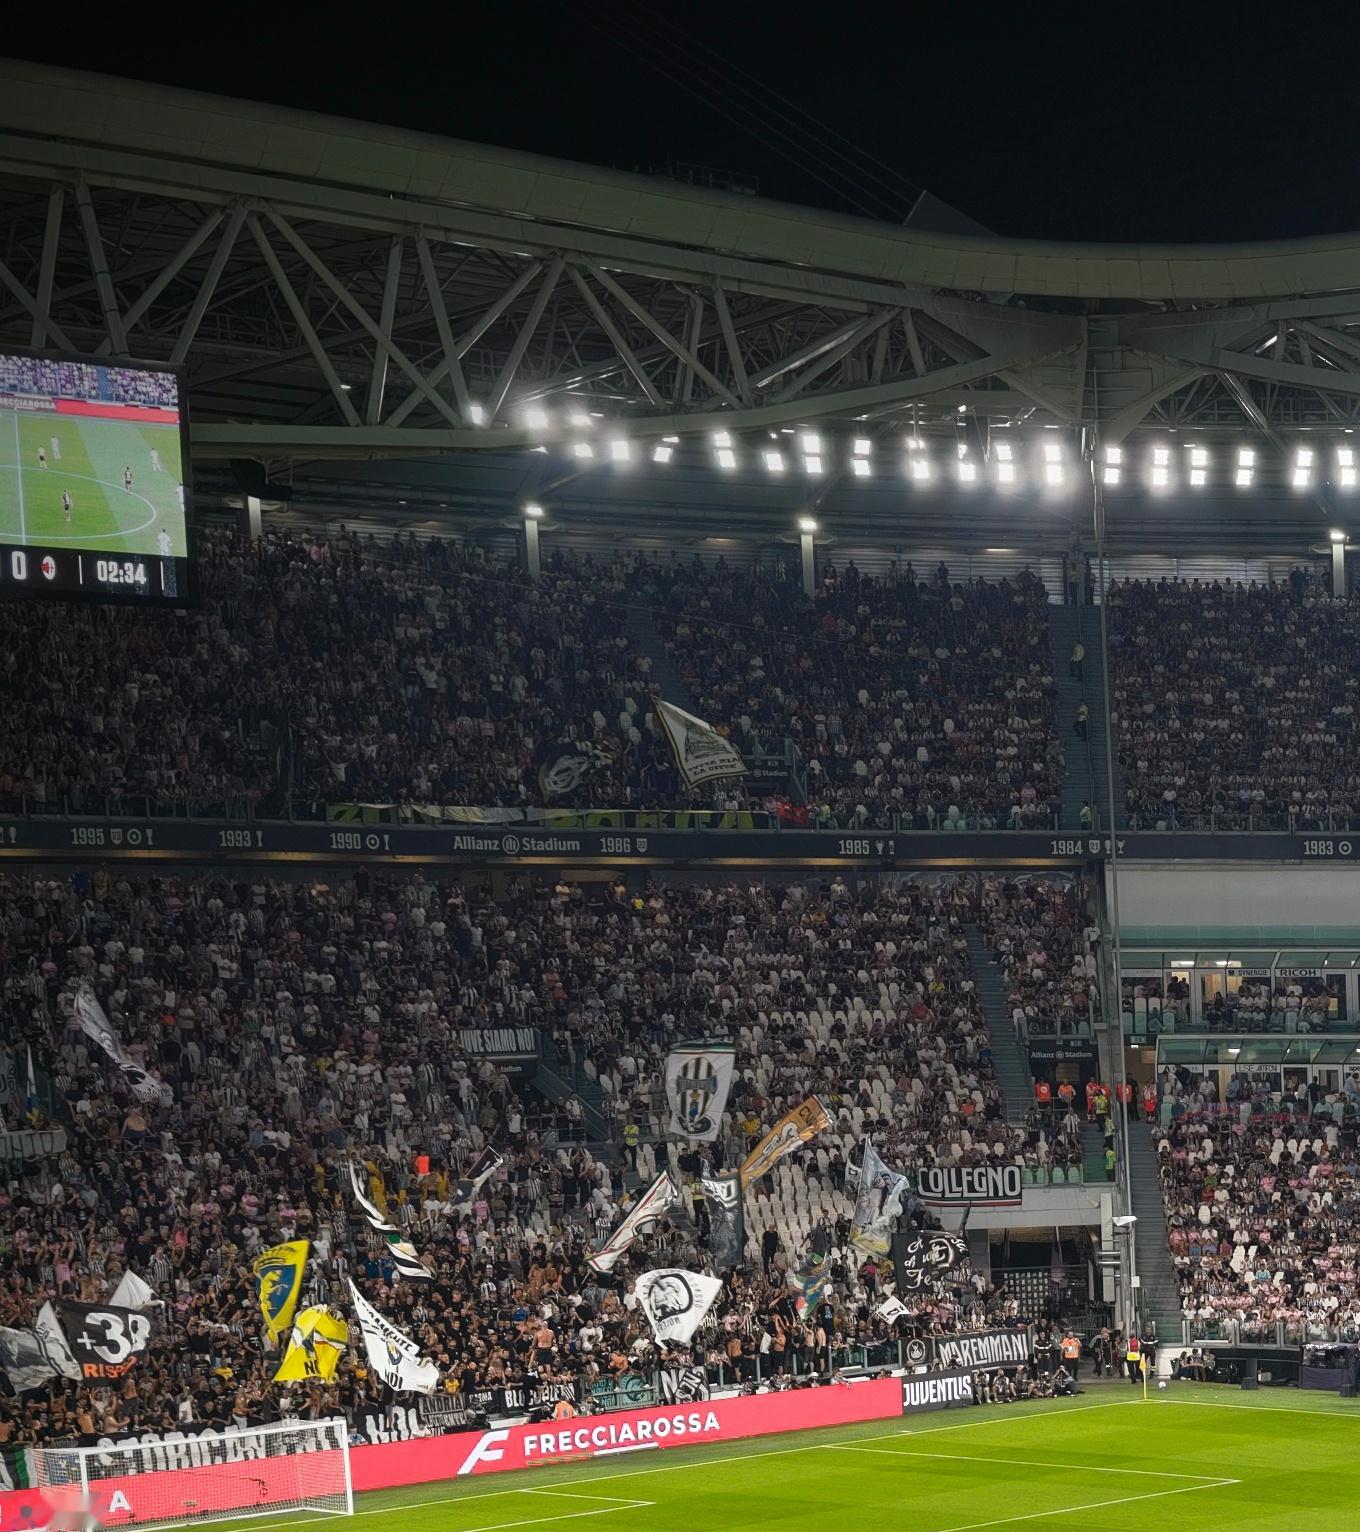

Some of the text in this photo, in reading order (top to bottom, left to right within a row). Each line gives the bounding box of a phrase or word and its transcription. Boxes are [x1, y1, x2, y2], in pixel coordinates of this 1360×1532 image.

[13, 551, 28, 580] 0
[97, 560, 147, 585] 02:34
[71, 828, 105, 845] 1995
[219, 830, 252, 847] 1993
[330, 833, 362, 849] 1990
[454, 835, 580, 851] Allianz Stadium
[600, 838, 631, 853] 1986
[839, 840, 871, 855] 1985
[1050, 840, 1084, 855] 1984
[1303, 841, 1333, 855] 1983
[1238, 969, 1268, 977] SYNERGIE
[485, 1029, 515, 1052] SIAMO
[515, 1027, 536, 1051] NOI
[1031, 1050, 1092, 1059] Allianz Stadium
[917, 1166, 1022, 1198] COLLEGNO
[938, 1333, 1029, 1369] MAREMMANI
[904, 1375, 972, 1406] JUVENTUS
[423, 1394, 462, 1413] ANDRIA
[524, 1411, 721, 1456] FRECCIAROSSA
